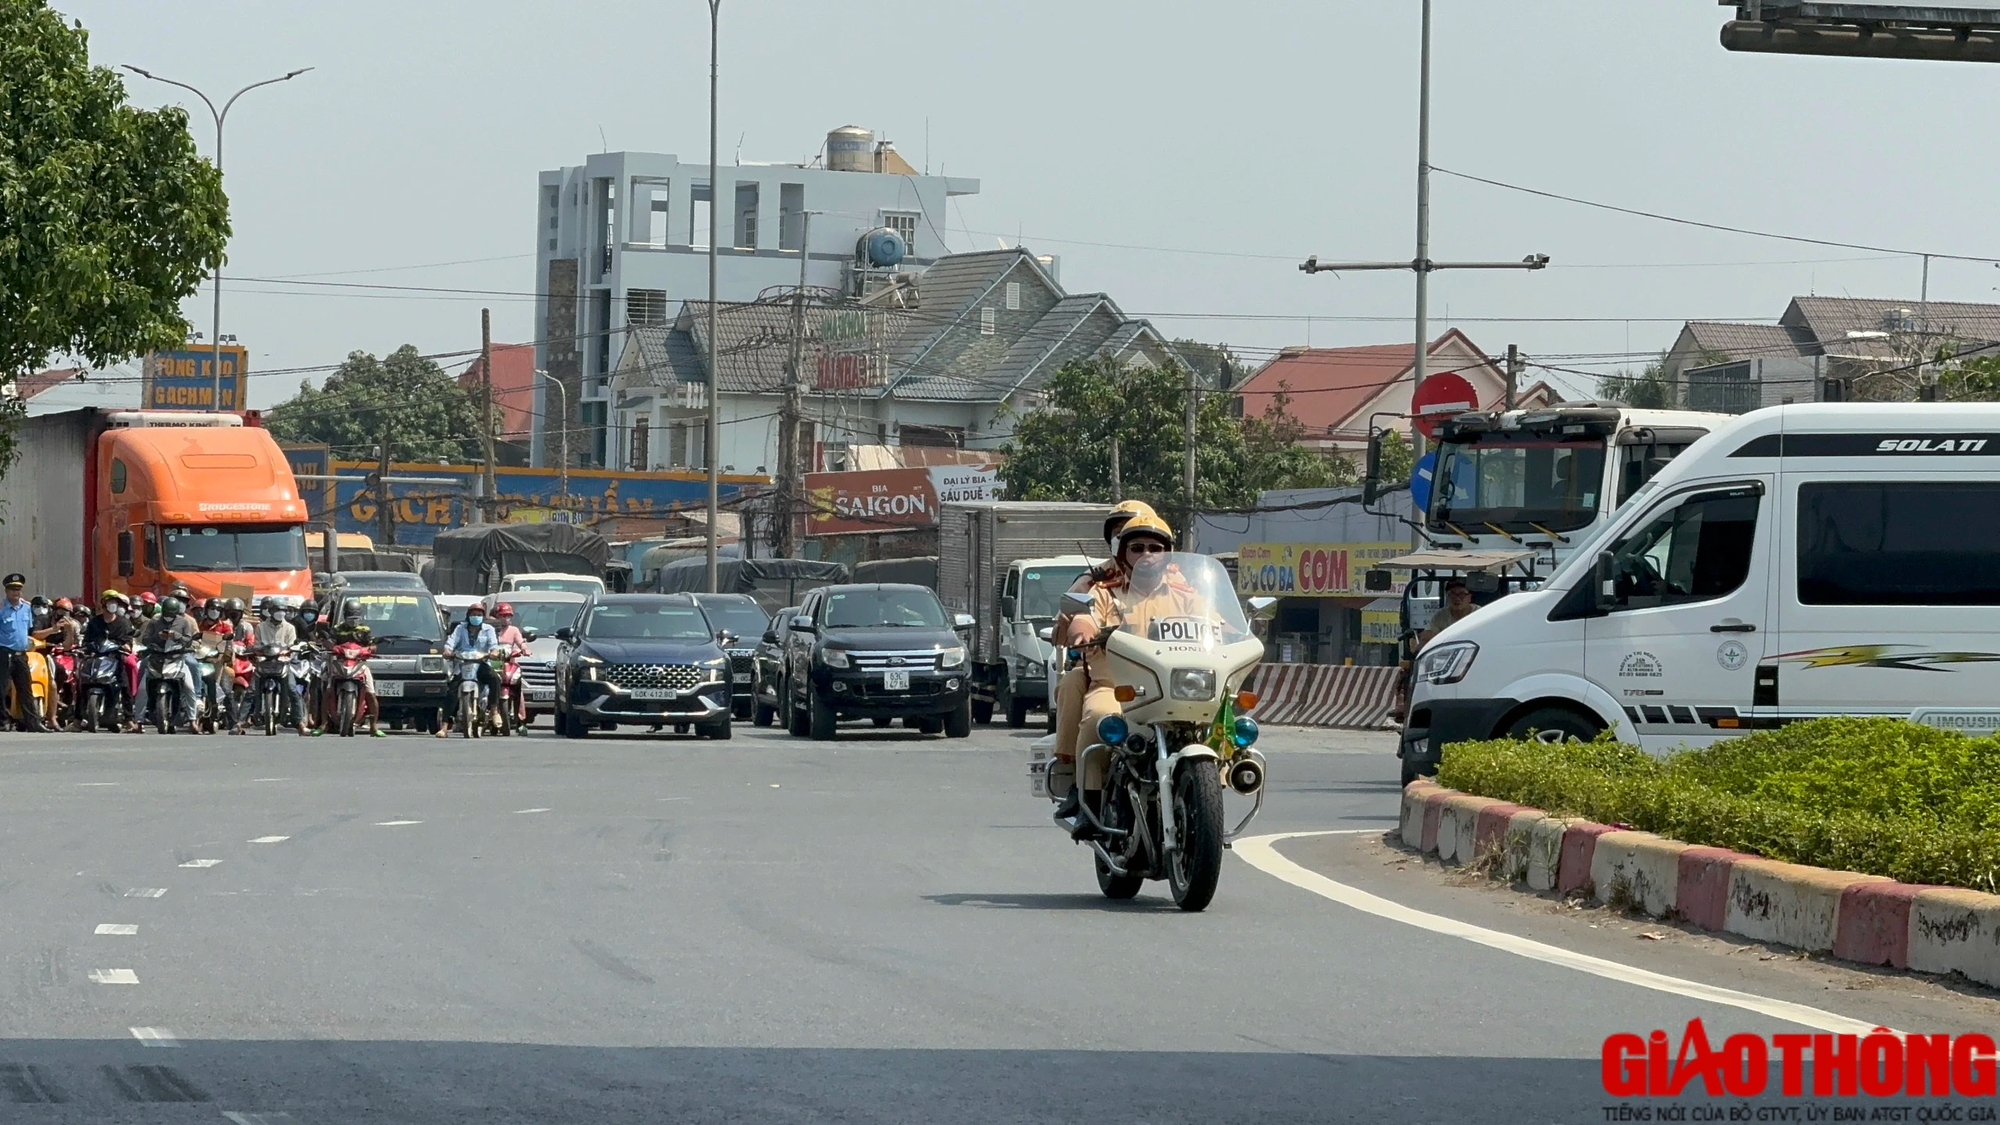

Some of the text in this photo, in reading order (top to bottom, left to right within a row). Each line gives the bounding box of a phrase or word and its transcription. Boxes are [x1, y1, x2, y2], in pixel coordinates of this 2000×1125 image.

[202, 360, 233, 377] KO
[1876, 439, 1988, 452] SOLATI
[872, 485, 888, 493] BIA
[943, 477, 959, 488] ĐẠI
[972, 476, 987, 484] BIA
[940, 487, 961, 503] SÁU
[199, 503, 271, 511] BRIDGESTONE
[836, 493, 926, 517] SAIGON
[1278, 566, 1295, 592] BA
[1160, 622, 1221, 643] POLICE
[1168, 646, 1215, 654] HOND
